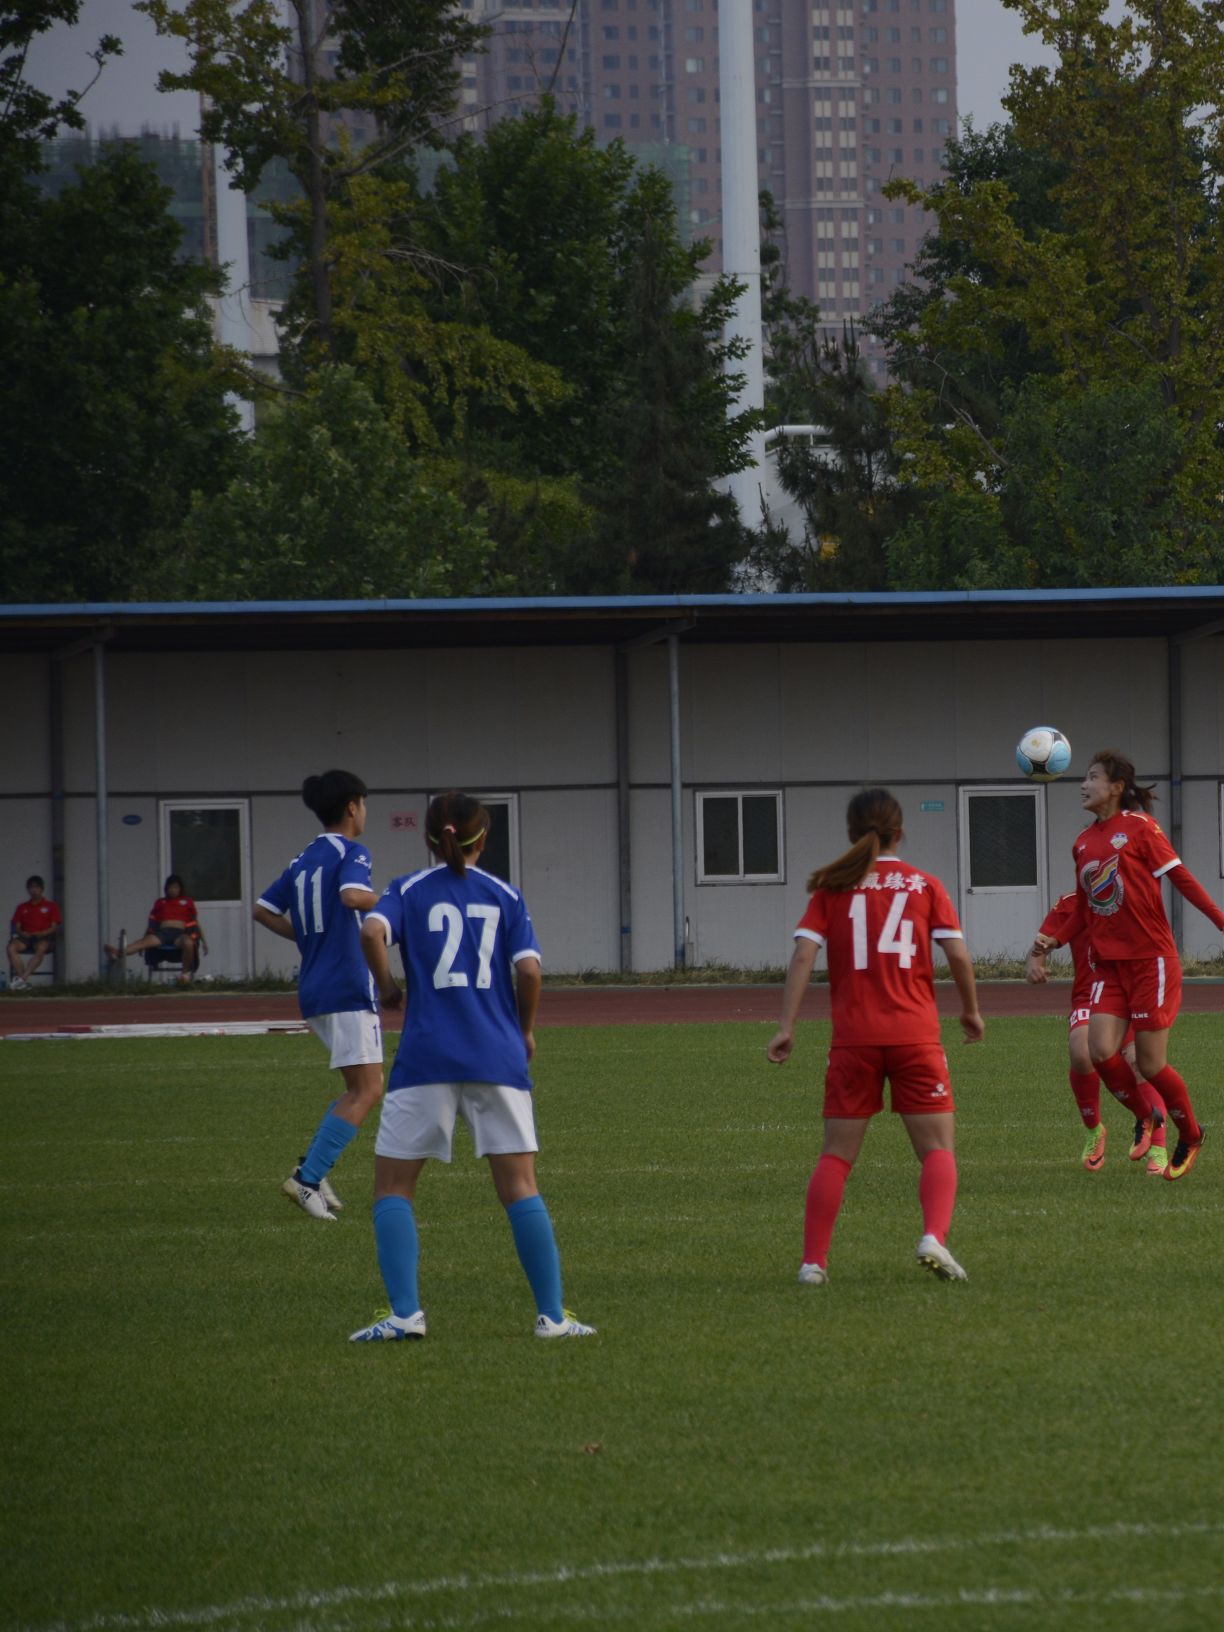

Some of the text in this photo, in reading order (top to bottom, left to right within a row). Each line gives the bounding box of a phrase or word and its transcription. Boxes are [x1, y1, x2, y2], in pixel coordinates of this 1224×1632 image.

[294, 866, 324, 935] 11
[848, 891, 917, 971] 14
[427, 902, 501, 990] 27
